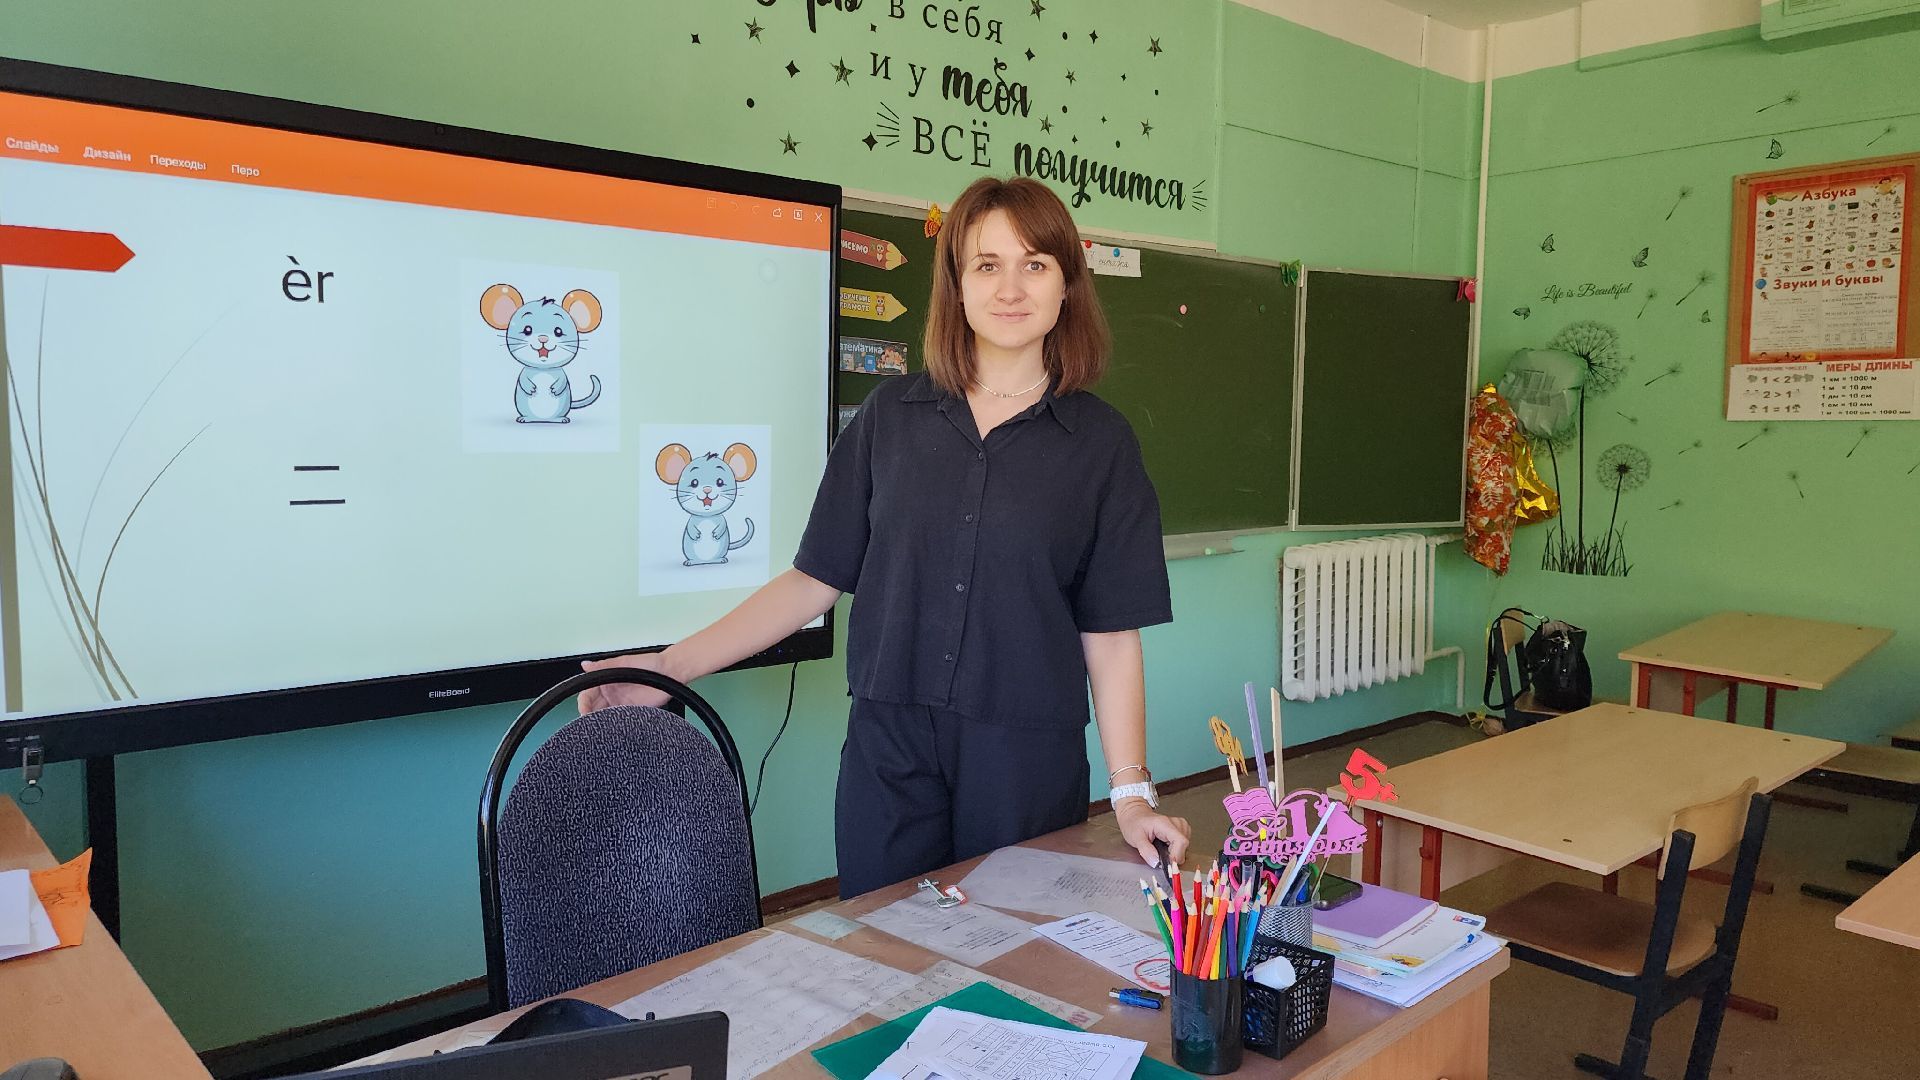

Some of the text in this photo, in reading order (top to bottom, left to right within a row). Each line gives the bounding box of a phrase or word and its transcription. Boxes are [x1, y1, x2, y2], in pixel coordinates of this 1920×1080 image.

[922, 4, 1003, 44] себя
[870, 52, 1032, 118] и у тебя
[5, 136, 60, 154] Слайды
[83, 146, 132, 162] Дизайн
[149, 154, 206, 171] Переходы
[231, 164, 260, 177] Перо
[912, 116, 1187, 210] ВСЁ получится
[1802, 187, 1857, 202] Азбука
[841, 239, 869, 254] ИСЬМО
[282, 254, 334, 303] èr
[1773, 274, 1884, 292] Звуки и буквы
[1540, 282, 1634, 304] Life is Beautiful
[840, 342, 884, 354] атематика
[1826, 360, 1913, 373] МЕРЫ ДЛИНЫ
[1784, 375, 1791, 384] 2
[1763, 390, 1771, 399] 2
[428, 687, 470, 699] EliteBoard
